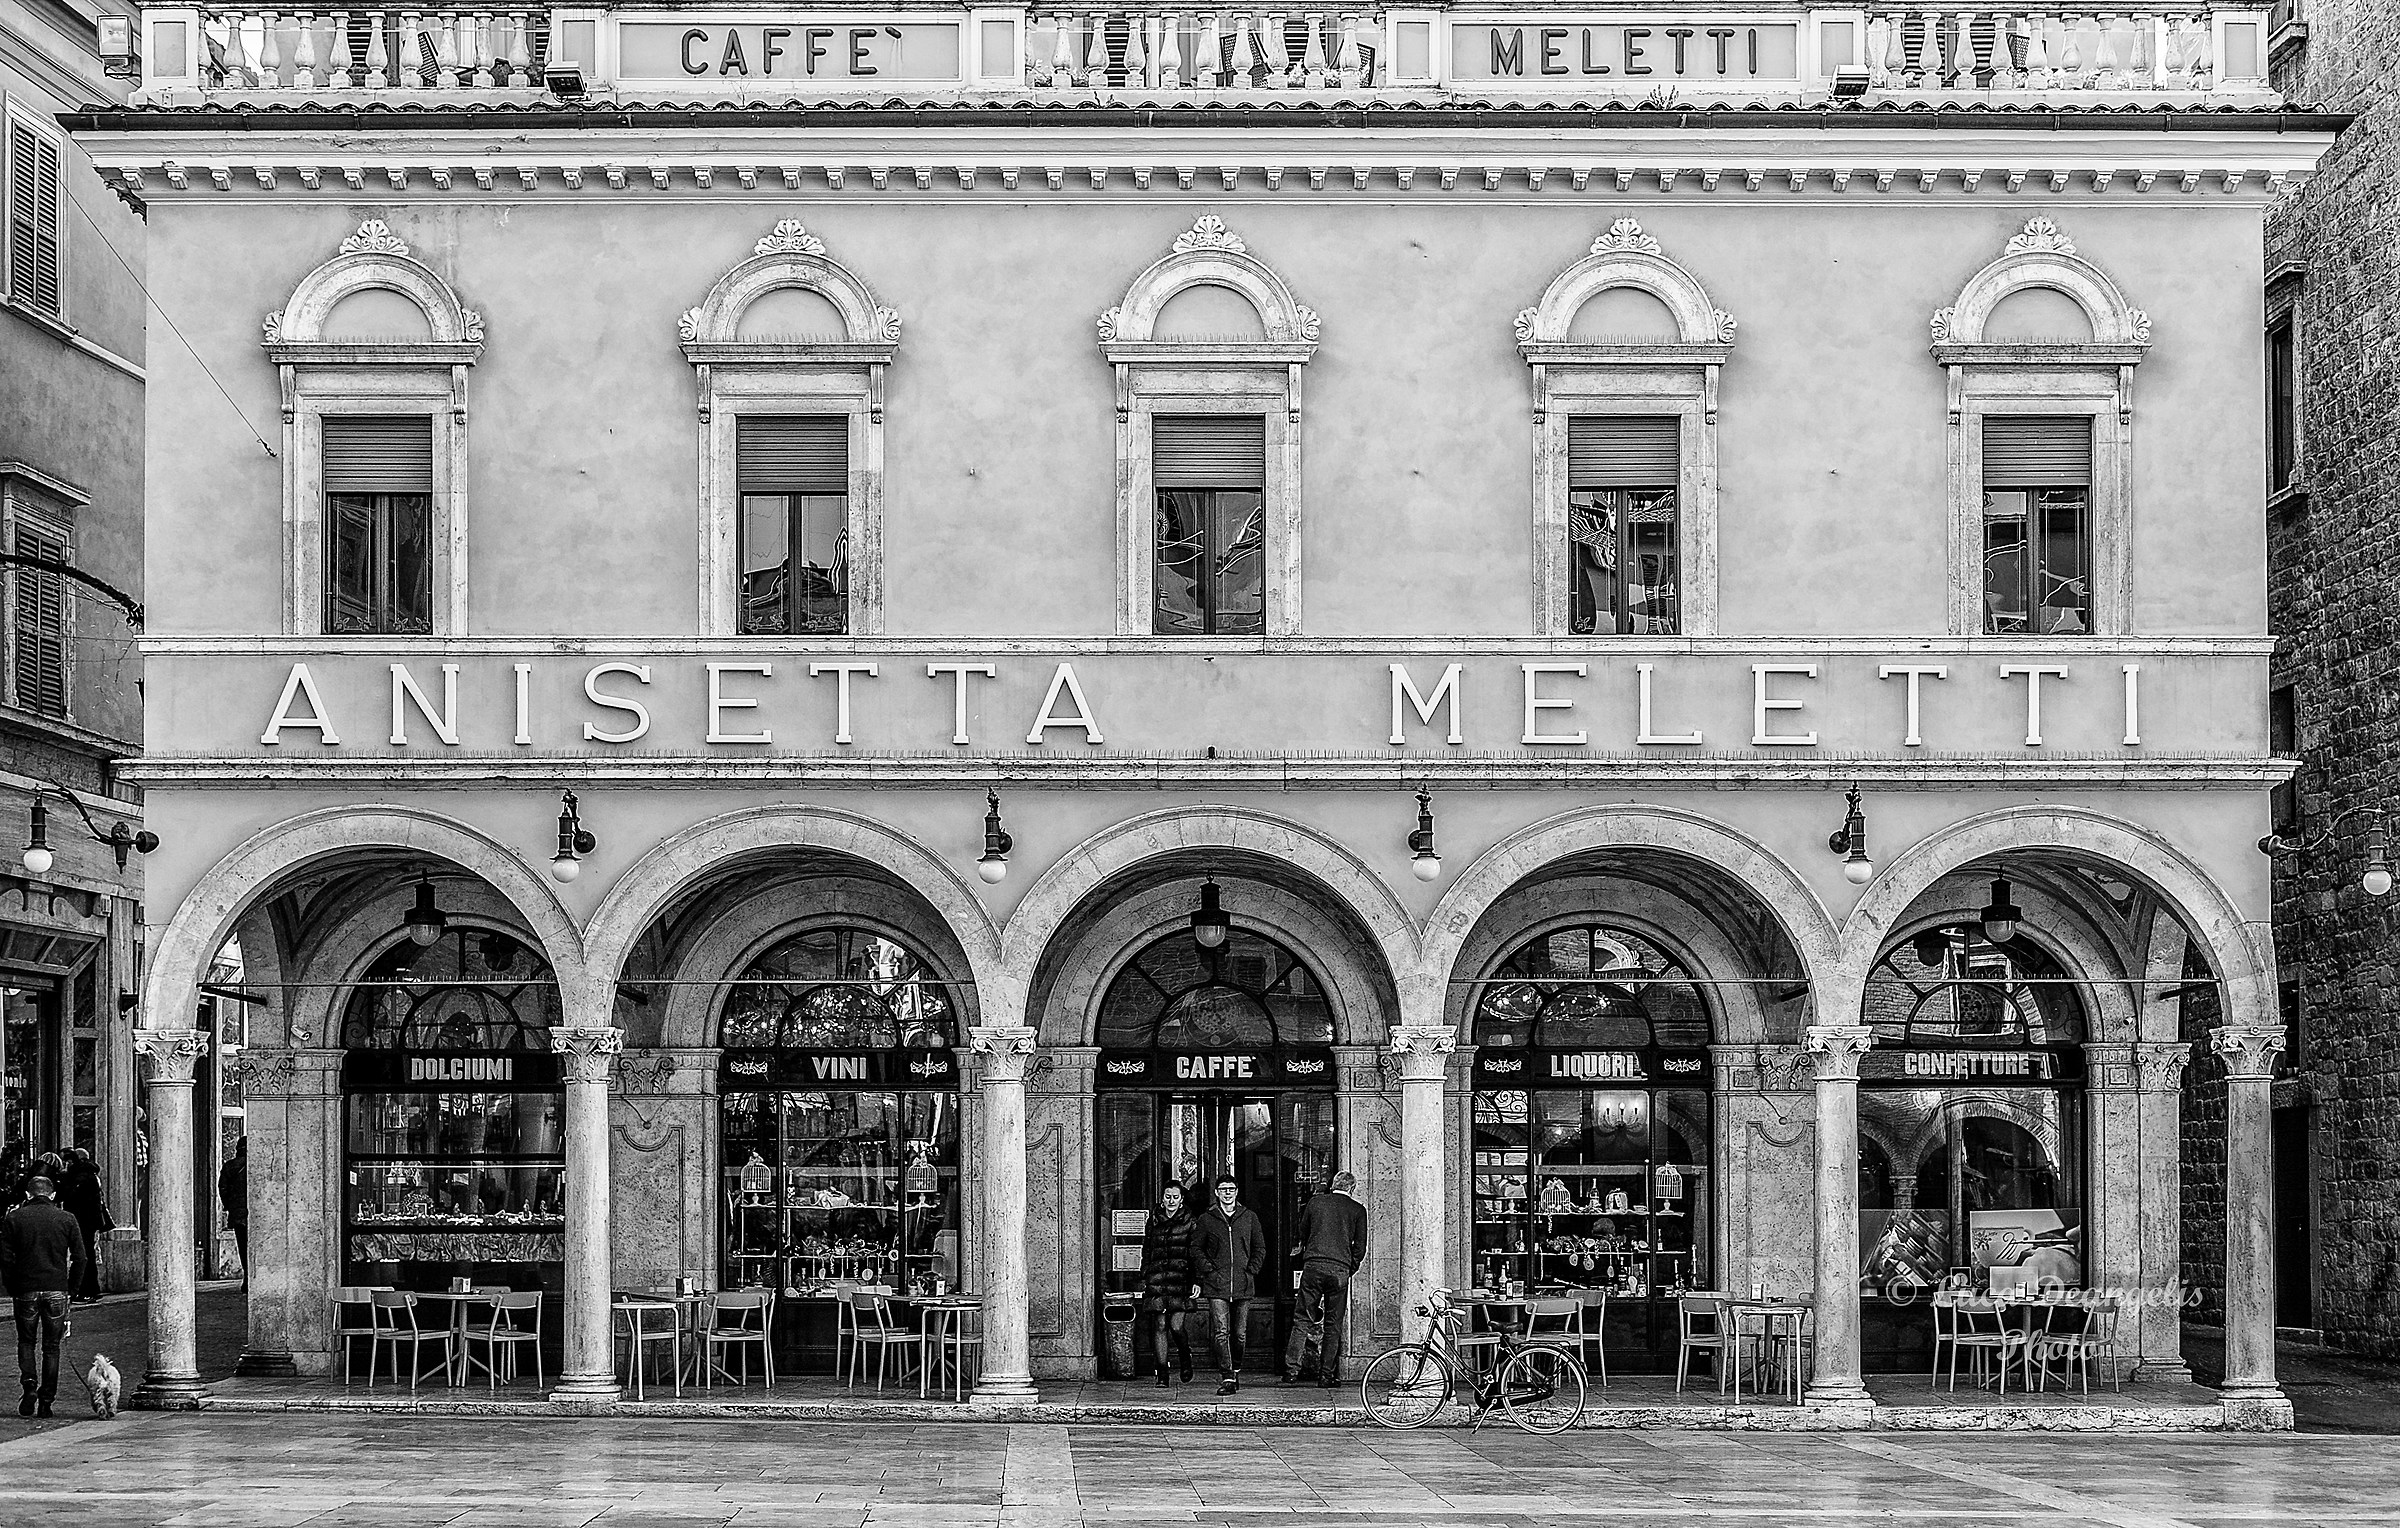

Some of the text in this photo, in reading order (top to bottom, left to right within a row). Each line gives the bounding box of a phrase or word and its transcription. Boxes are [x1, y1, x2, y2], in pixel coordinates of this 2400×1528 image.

[1490, 27, 1758, 77] MELETTI
[260, 662, 2142, 746] ANISETTA MELETTI
[411, 1057, 513, 1081] DOLCIUMI
[811, 1056, 867, 1081] VINI
[1551, 1054, 1634, 1077] LIQUORI
[1904, 1052, 2030, 1075] CONFETTURE
